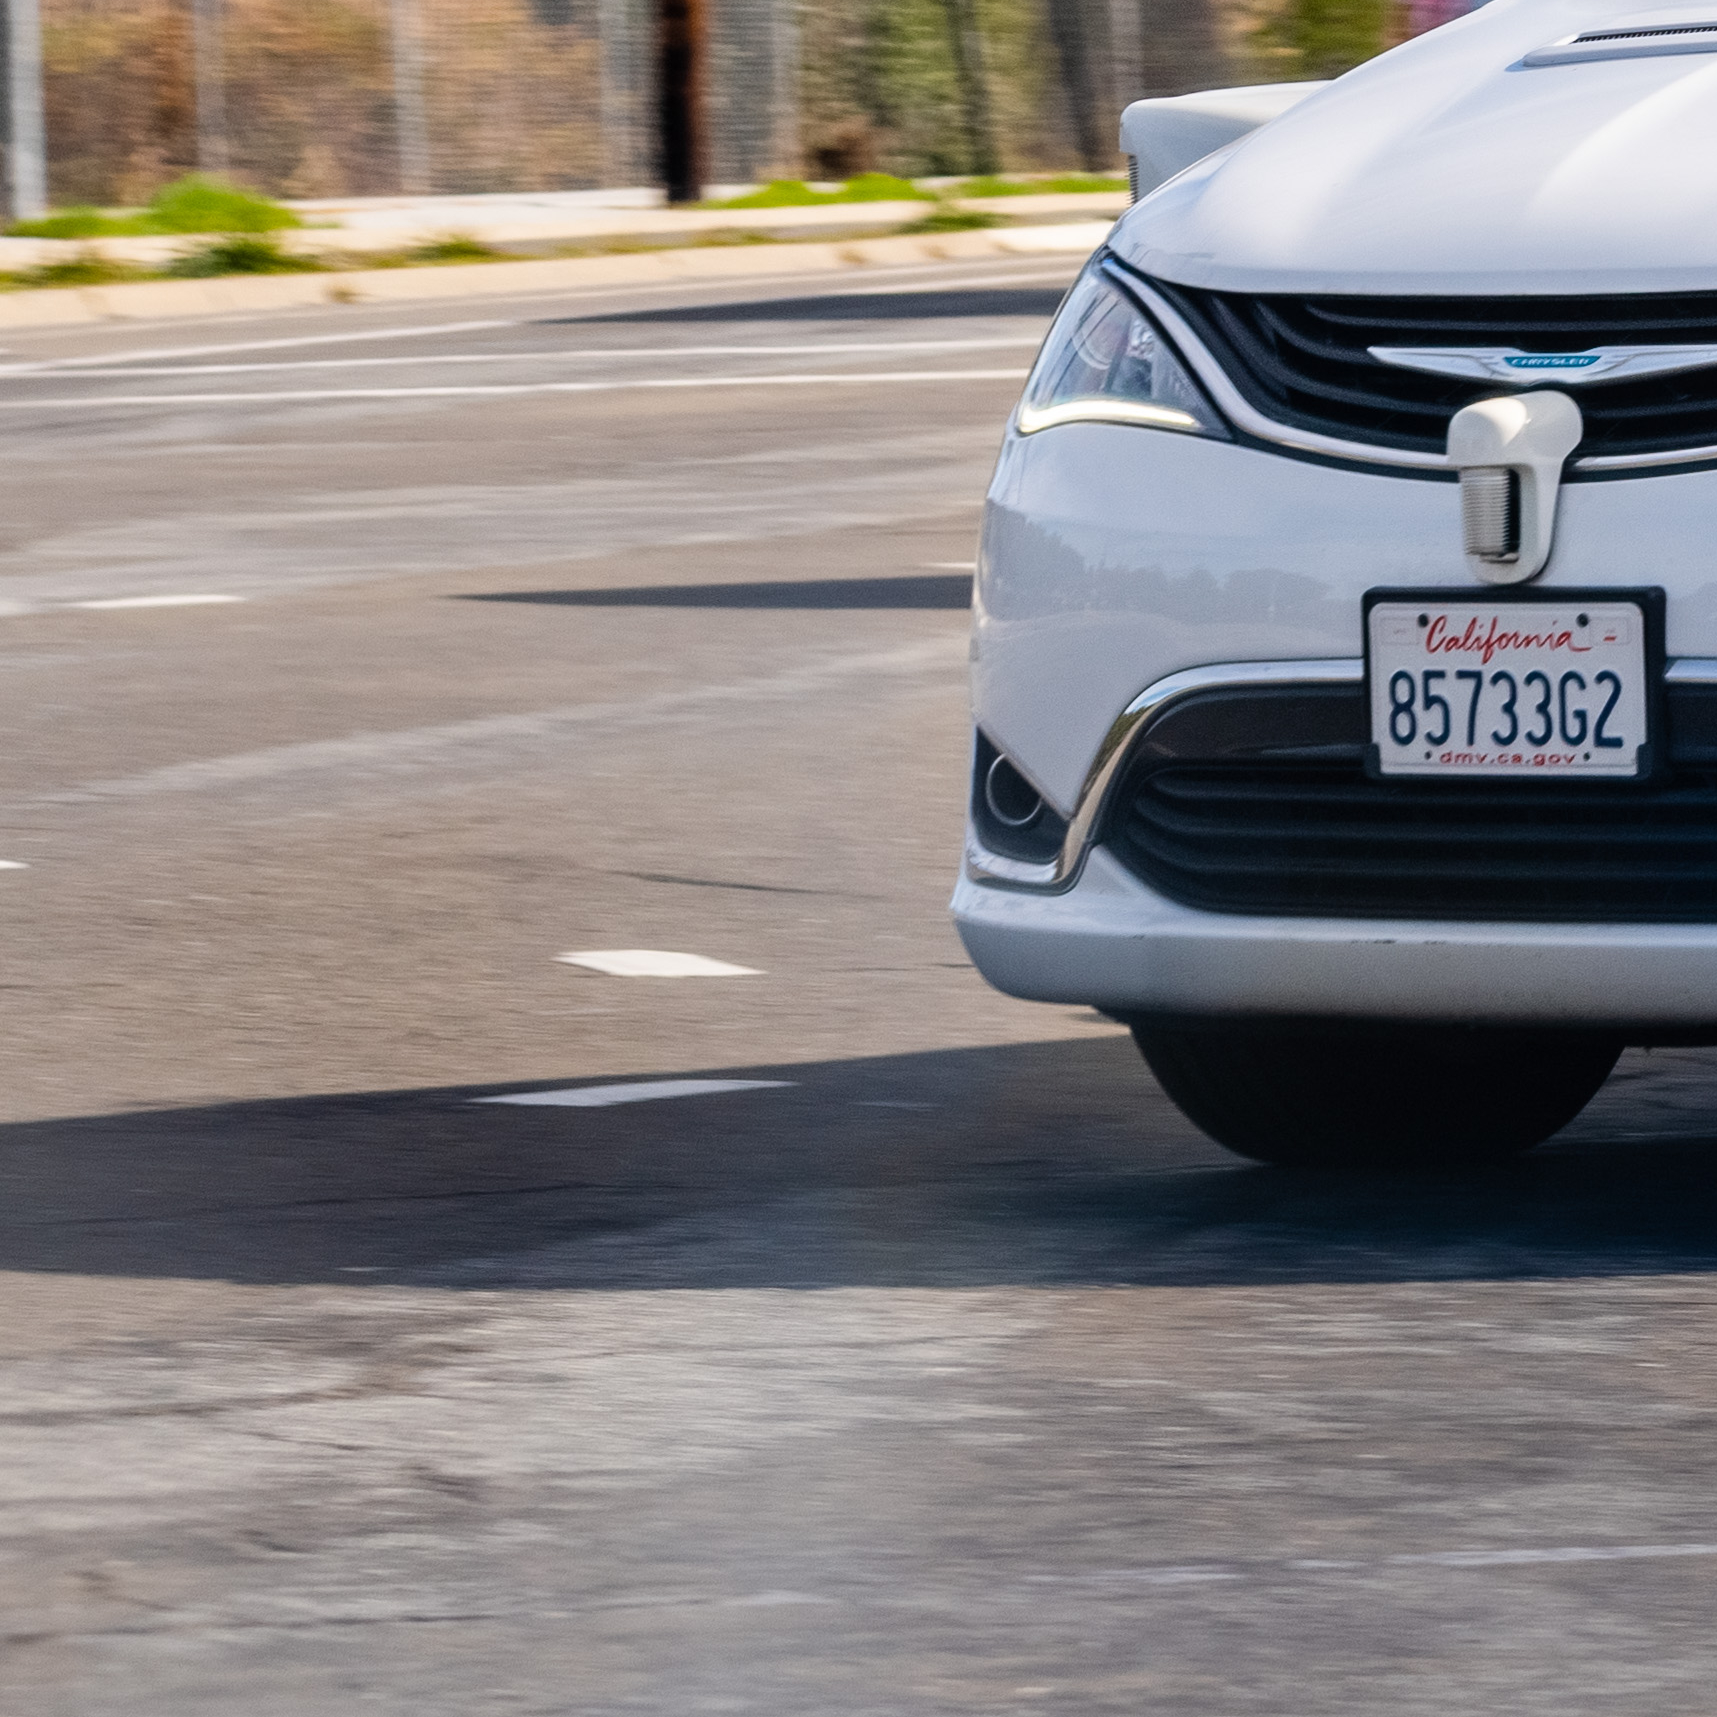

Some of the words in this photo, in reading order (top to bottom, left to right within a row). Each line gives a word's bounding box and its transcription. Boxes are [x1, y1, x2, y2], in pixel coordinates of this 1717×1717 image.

[1511, 357, 1590, 365] CHRYSLER
[1425, 615, 1592, 665] California
[1389, 670, 1624, 748] 85733G2
[1439, 750, 1576, 766] dmv.ca.gov
